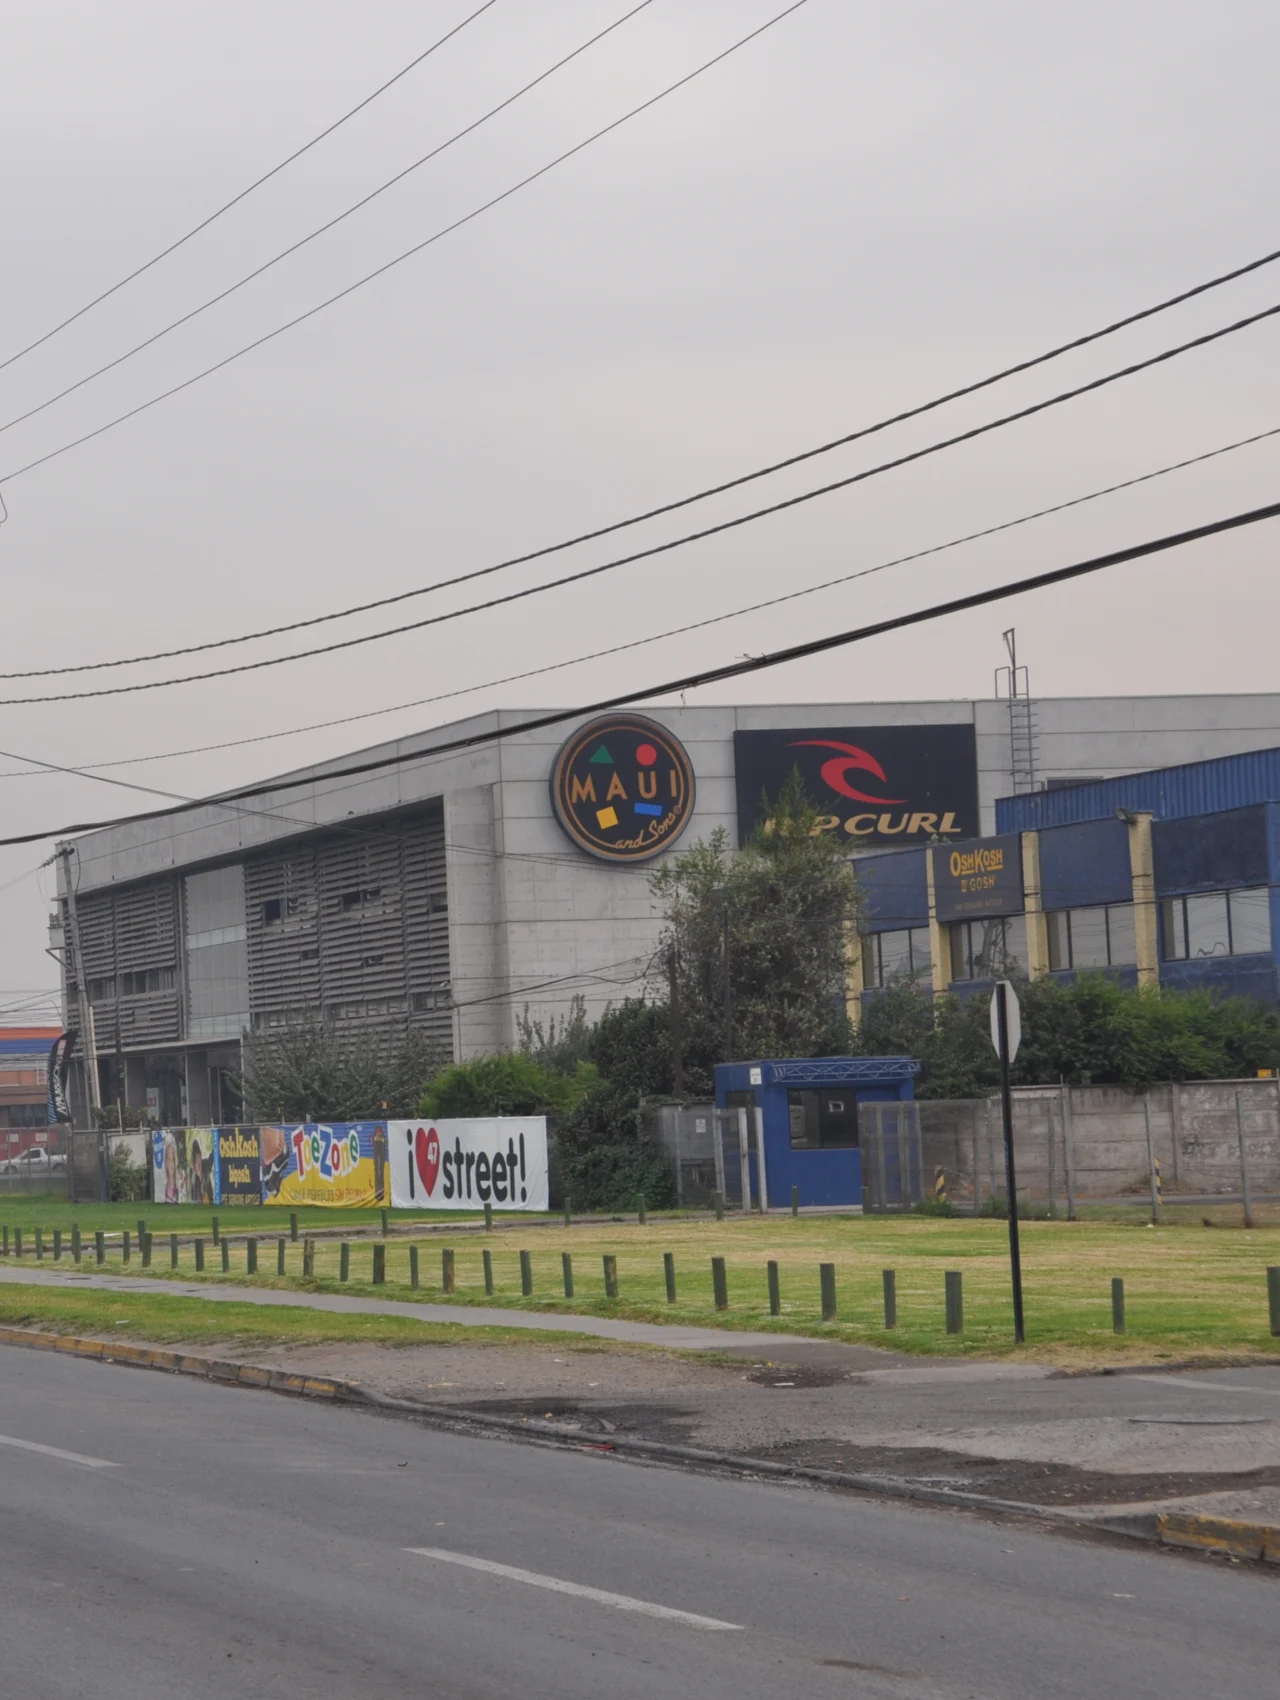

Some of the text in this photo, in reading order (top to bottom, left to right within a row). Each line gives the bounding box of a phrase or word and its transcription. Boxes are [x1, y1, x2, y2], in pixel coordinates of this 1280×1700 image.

[570, 768, 678, 804] MAUI
[615, 812, 677, 849] and Sons
[406, 1128, 528, 1204] i street!
[427, 1141, 438, 1165] 47
